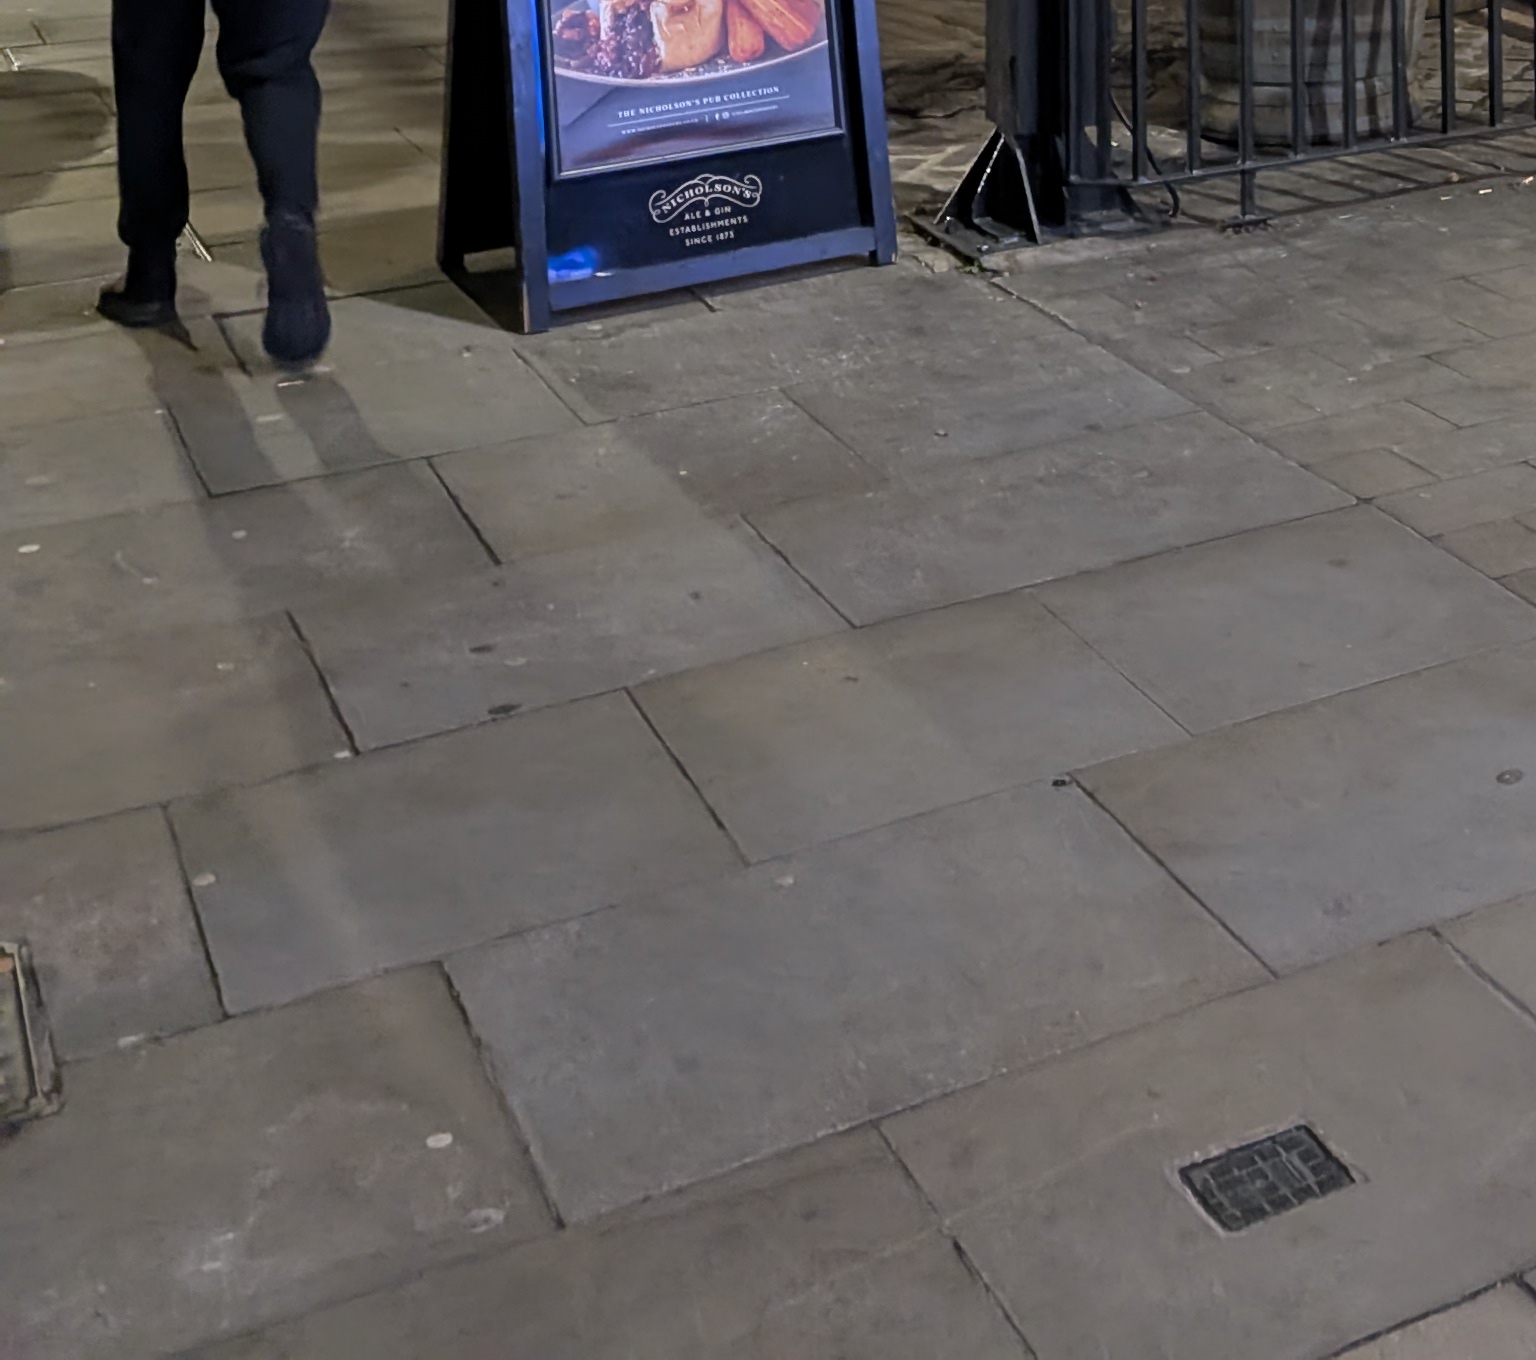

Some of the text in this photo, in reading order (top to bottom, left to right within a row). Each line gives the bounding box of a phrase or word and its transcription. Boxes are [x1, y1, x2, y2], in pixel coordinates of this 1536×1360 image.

[661, 183, 752, 214] NICHOLSON'S
[684, 210, 702, 220] ALE
[714, 206, 732, 216] GIN
[669, 215, 749, 237] ESTABLISHMENTS
[685, 234, 713, 247] SINCE
